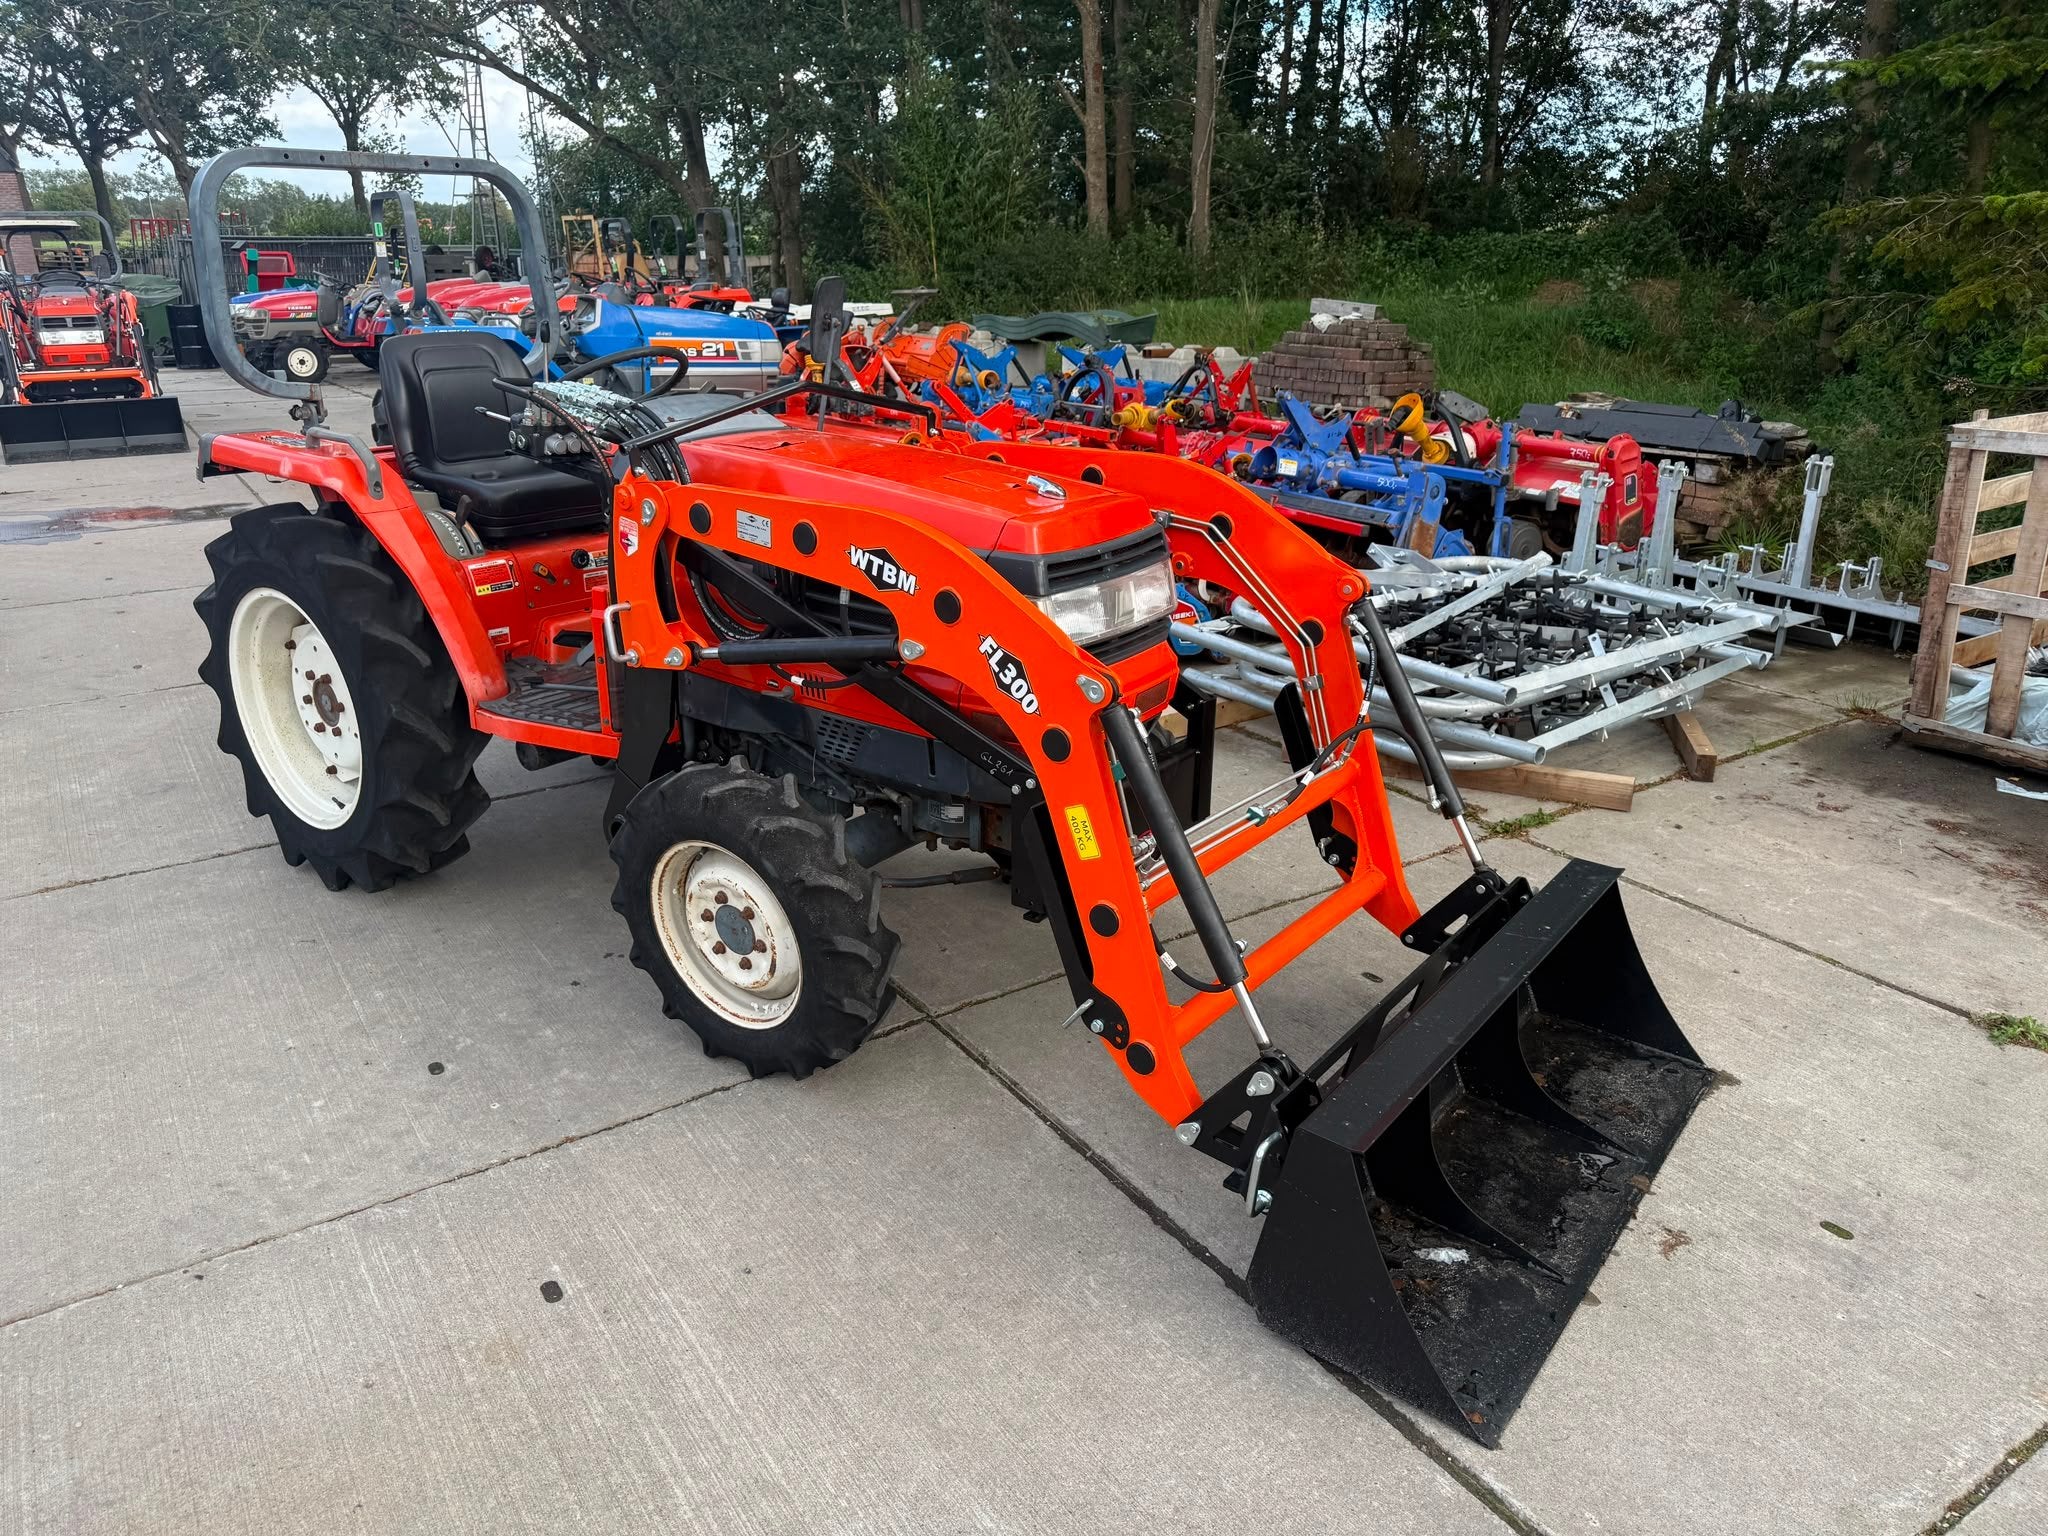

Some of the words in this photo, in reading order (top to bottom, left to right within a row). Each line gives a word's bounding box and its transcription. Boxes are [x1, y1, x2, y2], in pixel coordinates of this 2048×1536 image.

[701, 341, 725, 357] 21
[850, 544, 917, 596] WTBM
[978, 635, 1039, 714] FL300
[1071, 815, 1081, 834] 400
[1077, 836, 1091, 851] KG
[1080, 820, 1093, 842] MAX
